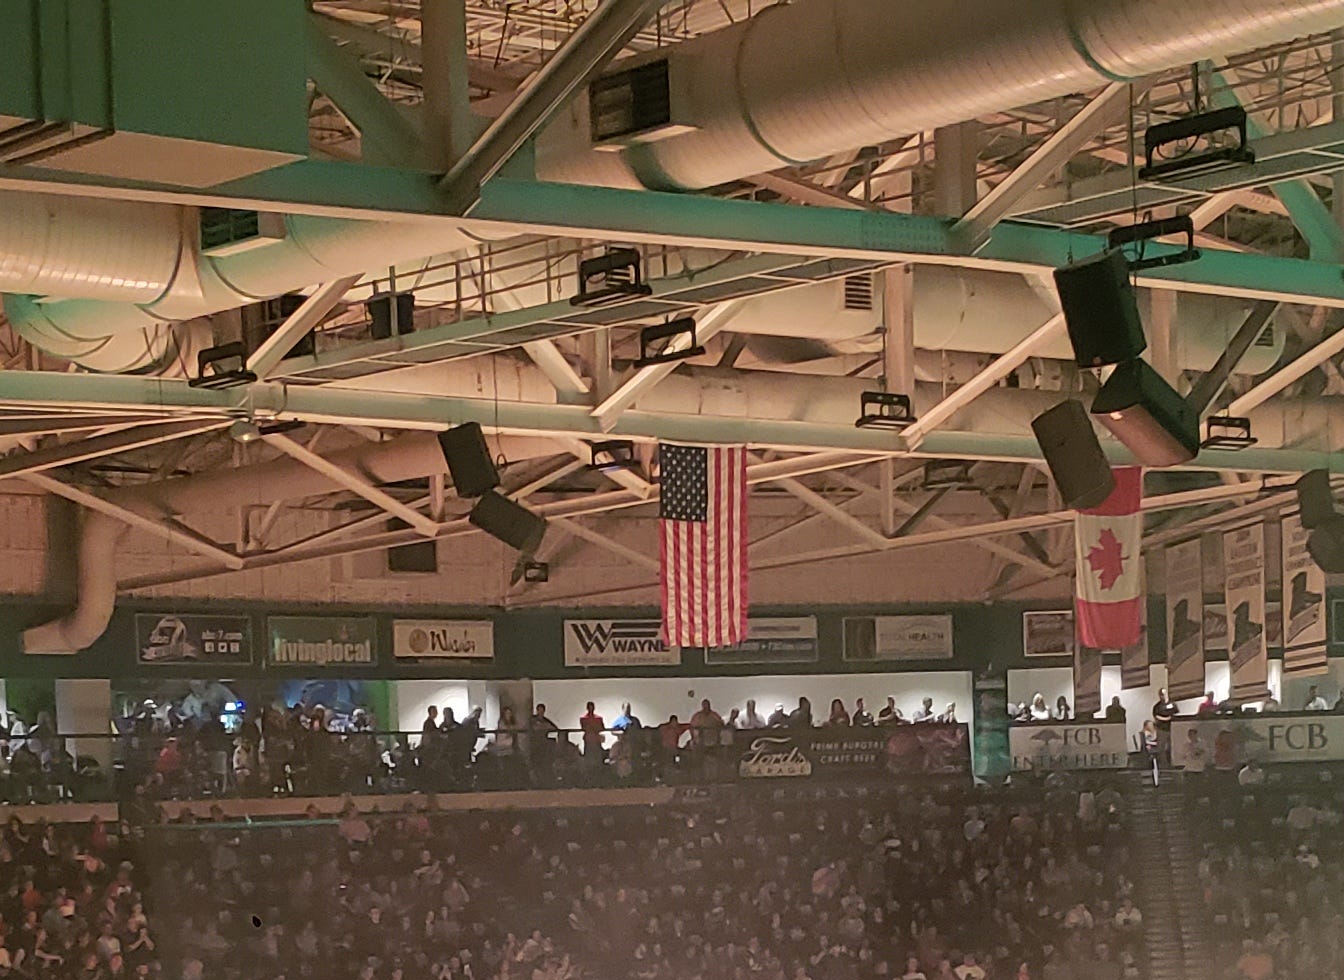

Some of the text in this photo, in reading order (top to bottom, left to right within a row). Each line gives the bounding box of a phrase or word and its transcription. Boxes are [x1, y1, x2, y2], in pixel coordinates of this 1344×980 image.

[274, 637, 371, 665] livinglocal
[1063, 727, 1102, 746] FCB
[1267, 723, 1329, 751] FCB
[1074, 751, 1123, 767] HERE
